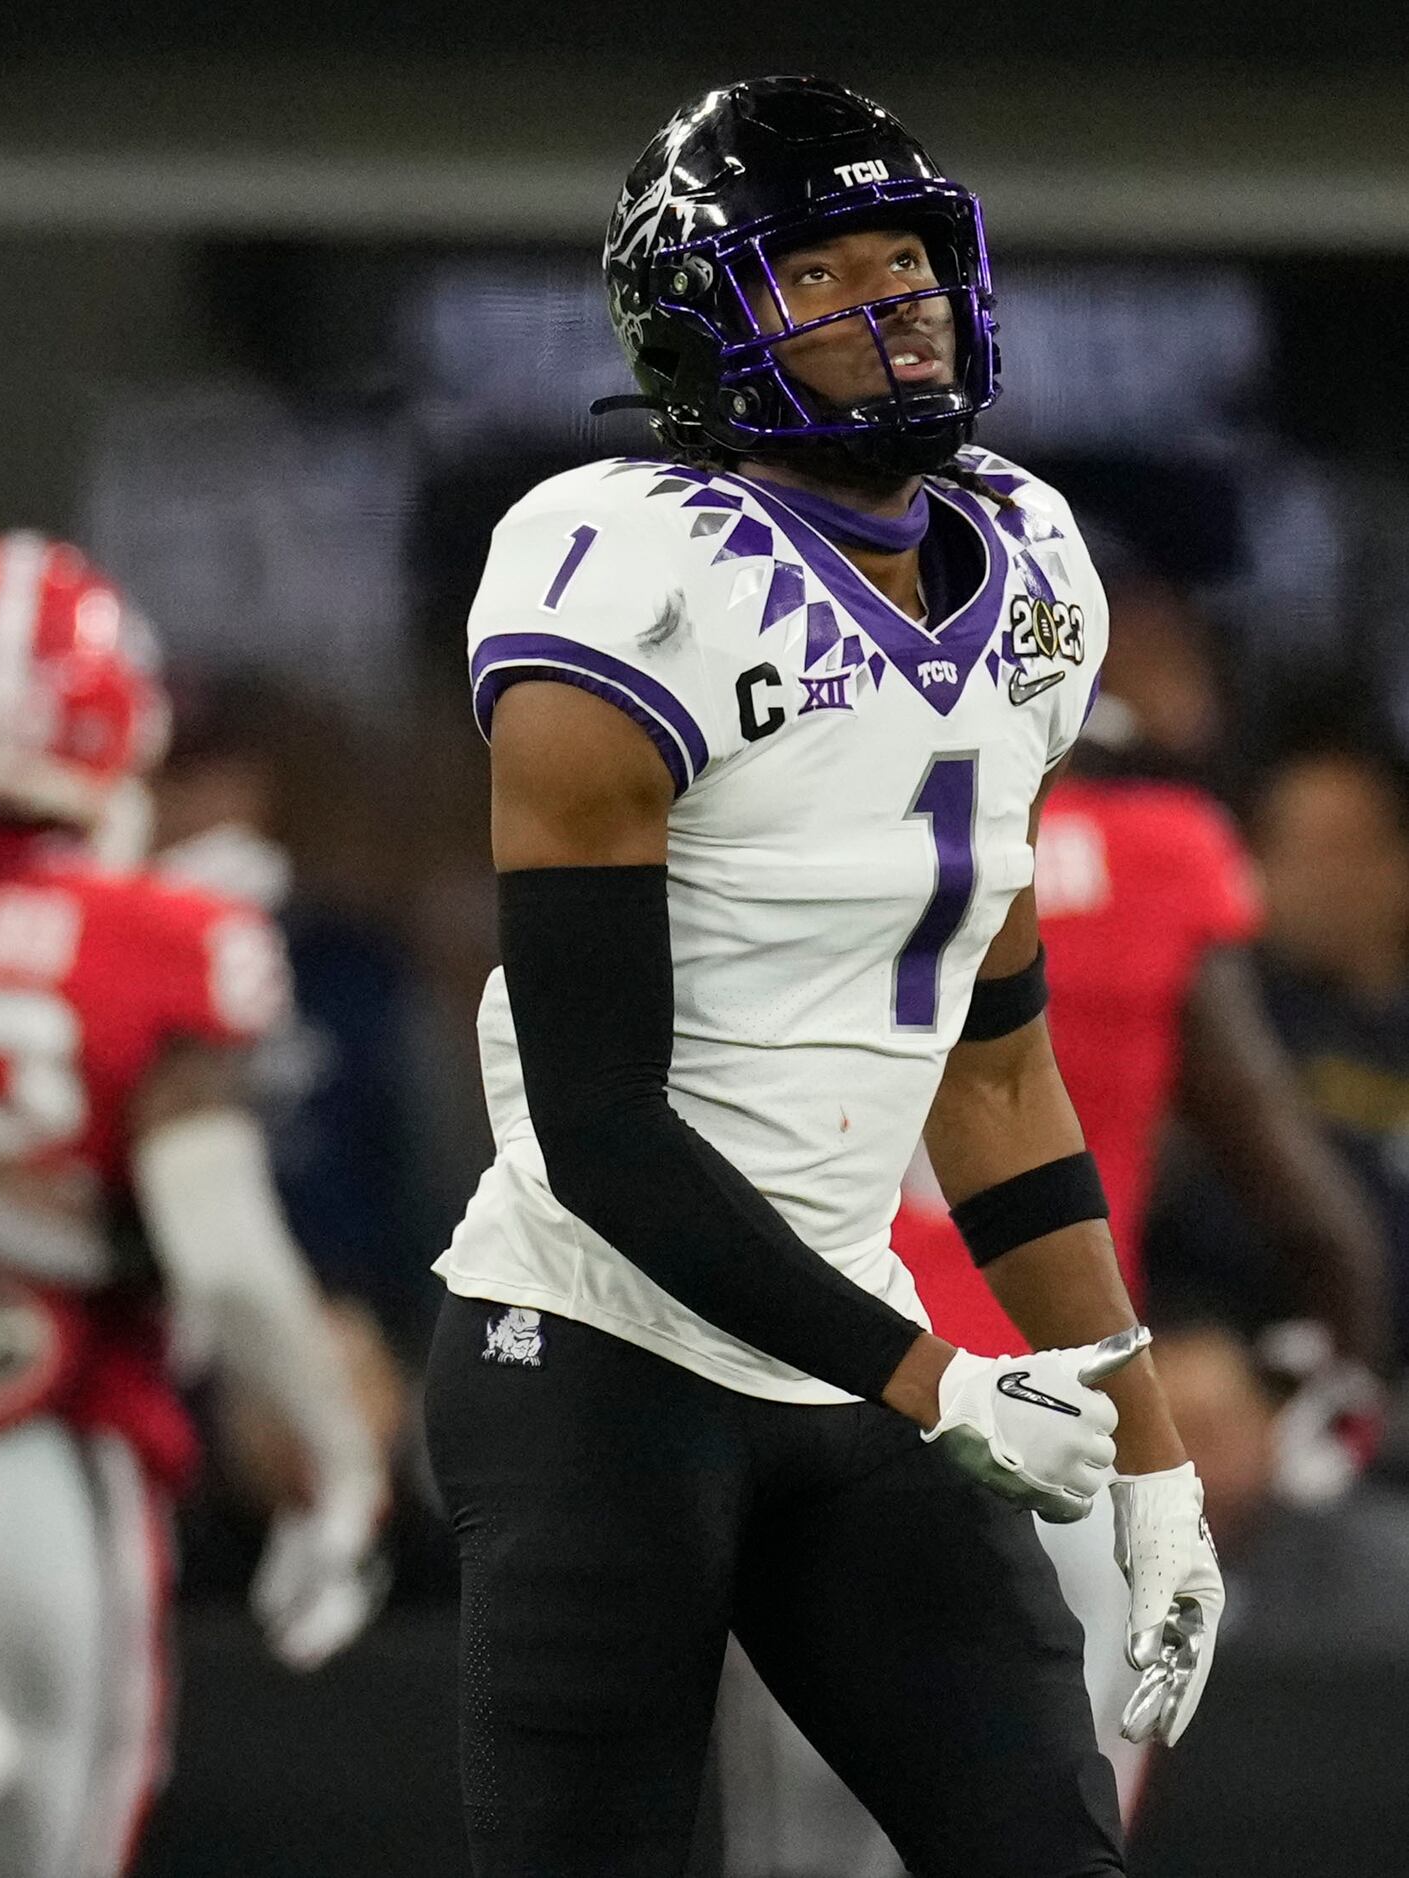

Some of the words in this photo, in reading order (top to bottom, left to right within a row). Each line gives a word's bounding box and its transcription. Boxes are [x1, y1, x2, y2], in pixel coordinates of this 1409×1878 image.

[833, 159, 890, 188] TCU
[540, 521, 600, 613] 1
[735, 661, 786, 743] C
[797, 672, 855, 717] XII
[917, 660, 959, 689] TCU
[890, 748, 981, 1034] 1
